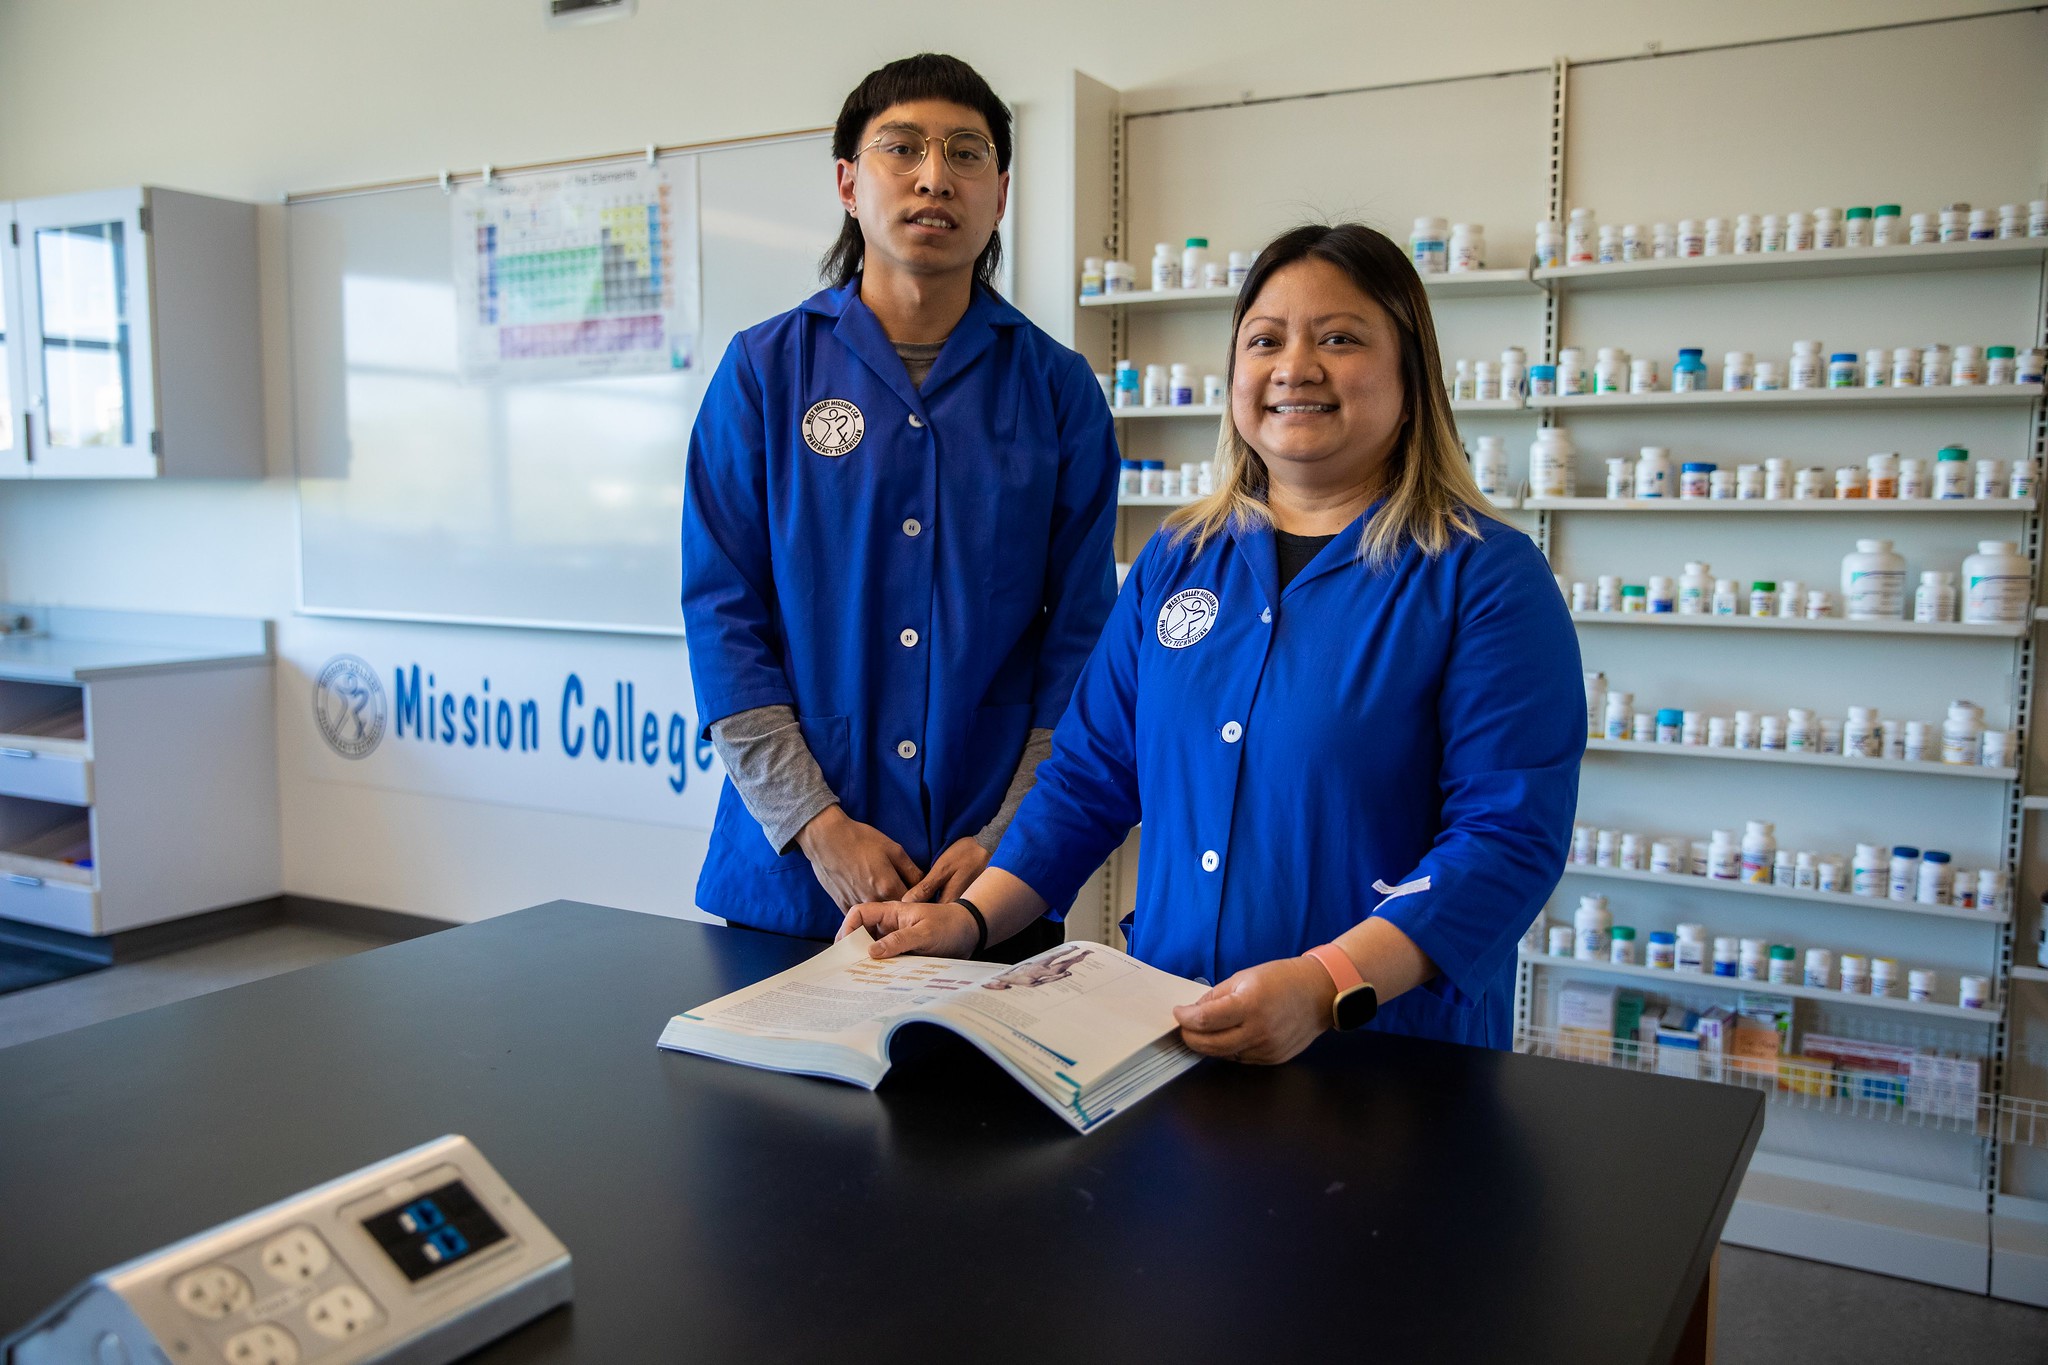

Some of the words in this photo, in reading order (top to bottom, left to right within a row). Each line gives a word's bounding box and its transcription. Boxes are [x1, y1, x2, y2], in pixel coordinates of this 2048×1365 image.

[805, 411, 815, 425] WEST
[813, 402, 830, 412] VALLEY
[831, 401, 852, 410] MISSION
[806, 433, 833, 454] PHARMACY
[834, 429, 862, 454] TECHNICIAN
[1166, 595, 1180, 610] WEST
[1181, 590, 1201, 599] VALLEY
[1173, 628, 1208, 646] TECHNICIAN
[394, 663, 540, 752] Mission
[561, 672, 714, 795] College
